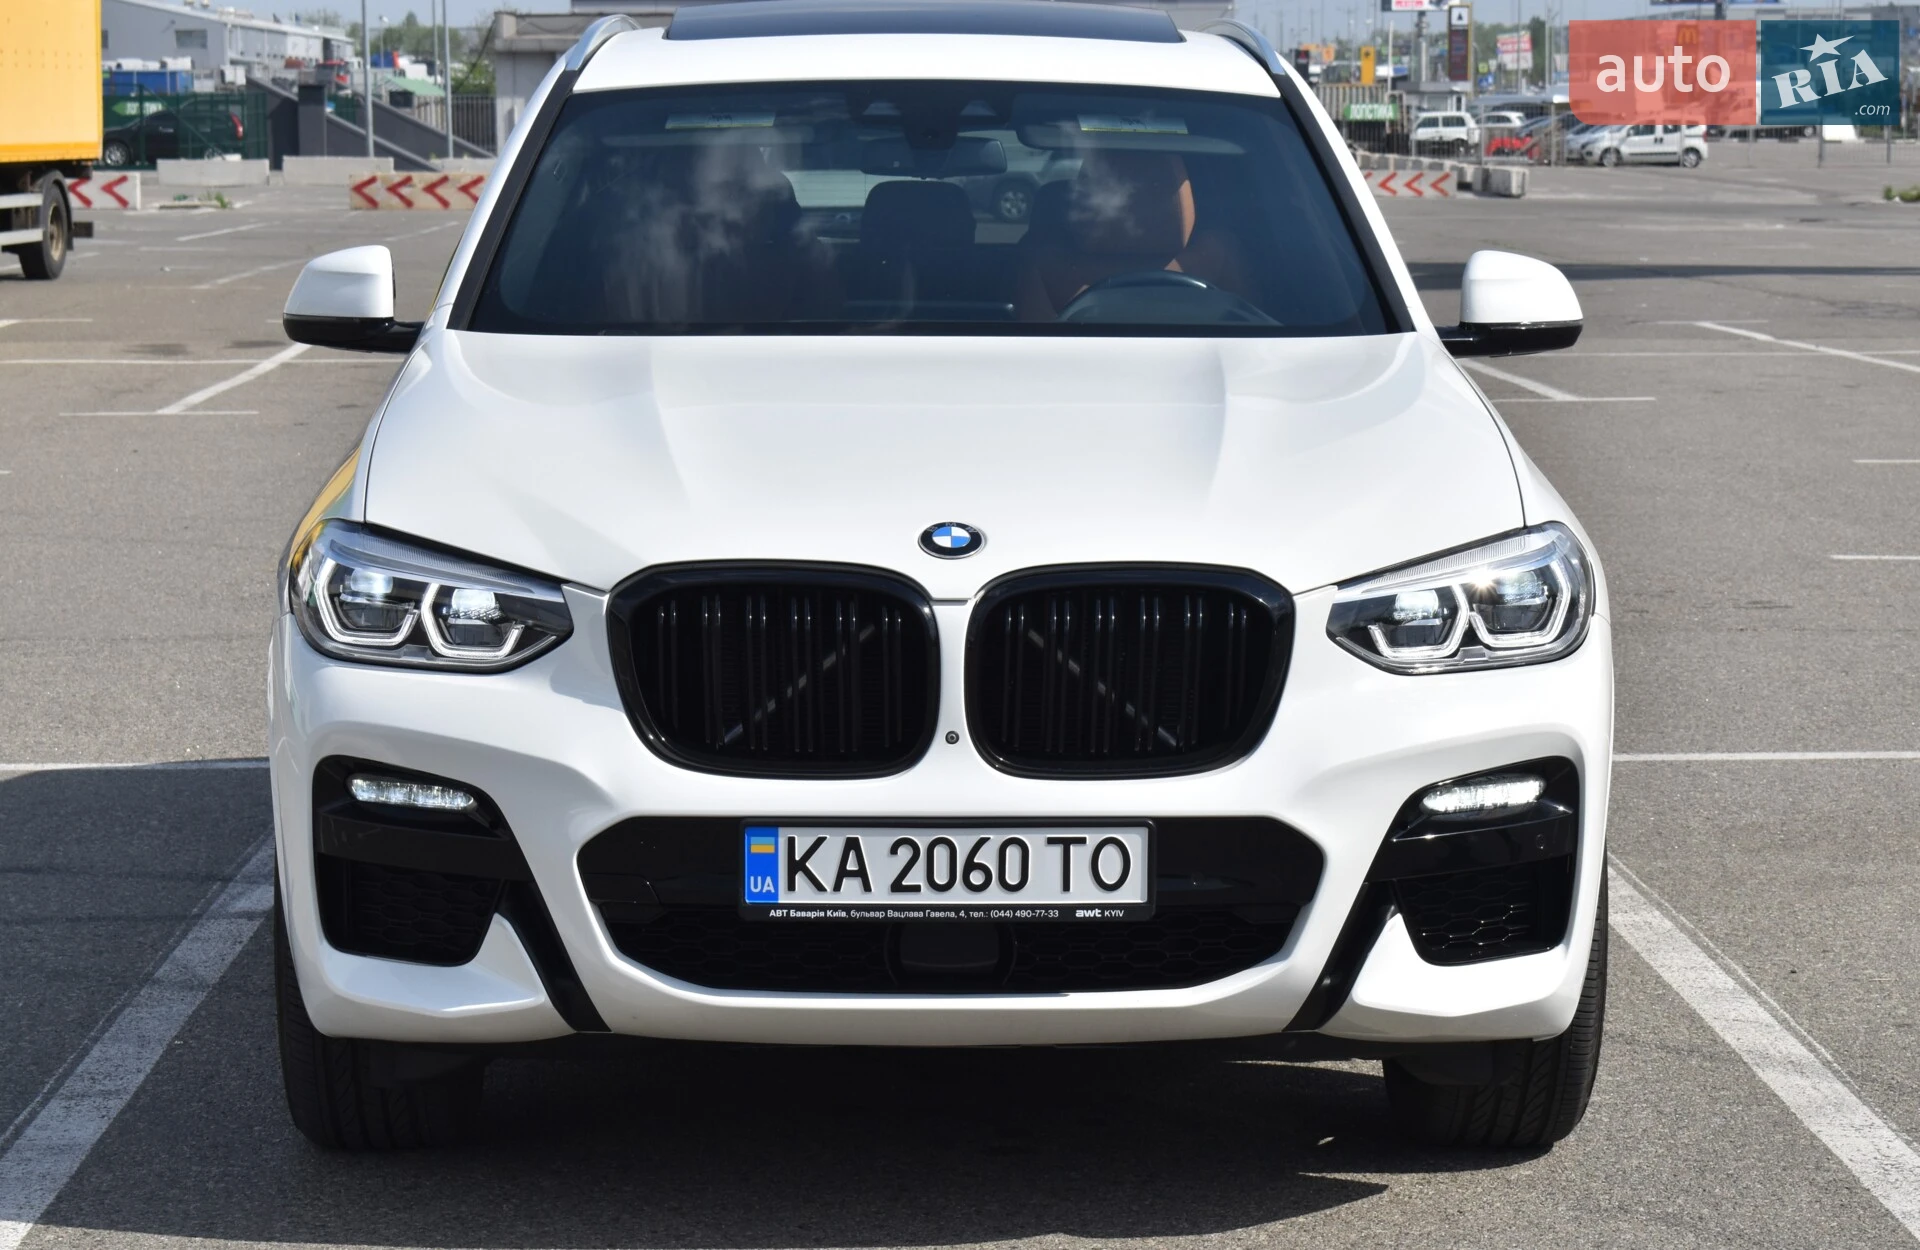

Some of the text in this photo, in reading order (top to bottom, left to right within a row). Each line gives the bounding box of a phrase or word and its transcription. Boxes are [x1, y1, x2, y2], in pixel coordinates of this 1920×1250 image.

[787, 836, 1132, 893] KA 2060 TO
[750, 876, 775, 893] UA
[769, 909, 788, 918] АВТ
[789, 909, 825, 919] Баварія
[826, 909, 849, 919] Київ,
[850, 909, 886, 919] бульвар
[887, 909, 924, 918] Вацлава
[925, 909, 958, 919] Гавела,
[990, 909, 1014, 919] (044)
[1015, 909, 1059, 918] 490-77-33
[1104, 909, 1125, 918] KYIV
